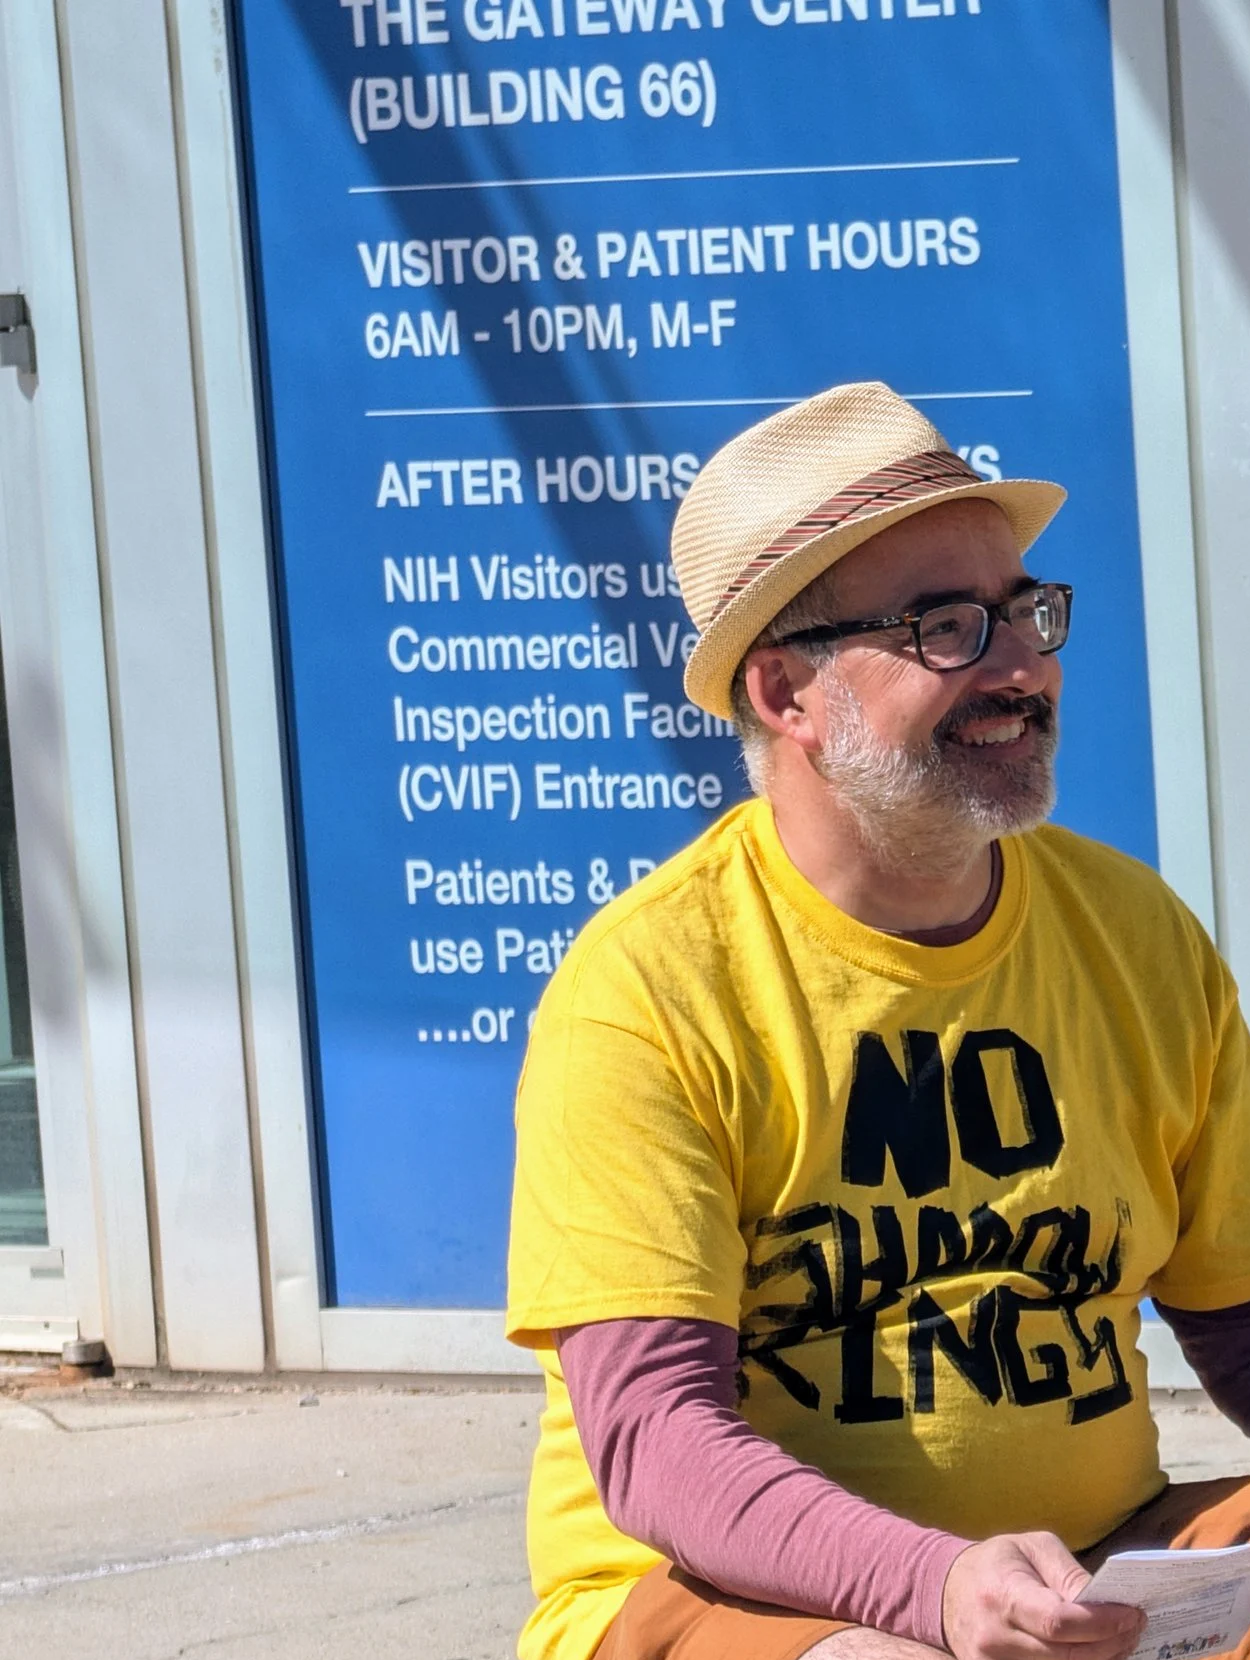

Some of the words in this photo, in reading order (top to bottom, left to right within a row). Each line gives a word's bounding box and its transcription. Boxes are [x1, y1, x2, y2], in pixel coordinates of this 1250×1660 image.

[341, 0, 449, 46] THE
[351, 65, 624, 143] (BUILDING
[640, 59, 716, 127] 66)
[358, 236, 540, 287] VISITOR
[554, 234, 585, 280] &
[597, 225, 794, 278] PATIENT
[808, 217, 981, 270] HOURS
[365, 311, 459, 358] 6AM
[505, 304, 637, 357] 10PM,
[651, 300, 736, 348] M-F
[377, 459, 523, 507] AFTER
[537, 453, 698, 502] HOURS
[384, 556, 459, 602] NIH
[470, 554, 627, 600] Visitors
[389, 624, 637, 672] Commercial
[394, 694, 610, 751] Inspection
[624, 693, 736, 739] Faci
[399, 764, 521, 821] (CVIF)
[535, 764, 721, 809] Entrance
[406, 859, 574, 905] Patients
[588, 858, 617, 904] &
[411, 939, 483, 973] use
[841, 1029, 1065, 1198] NO
